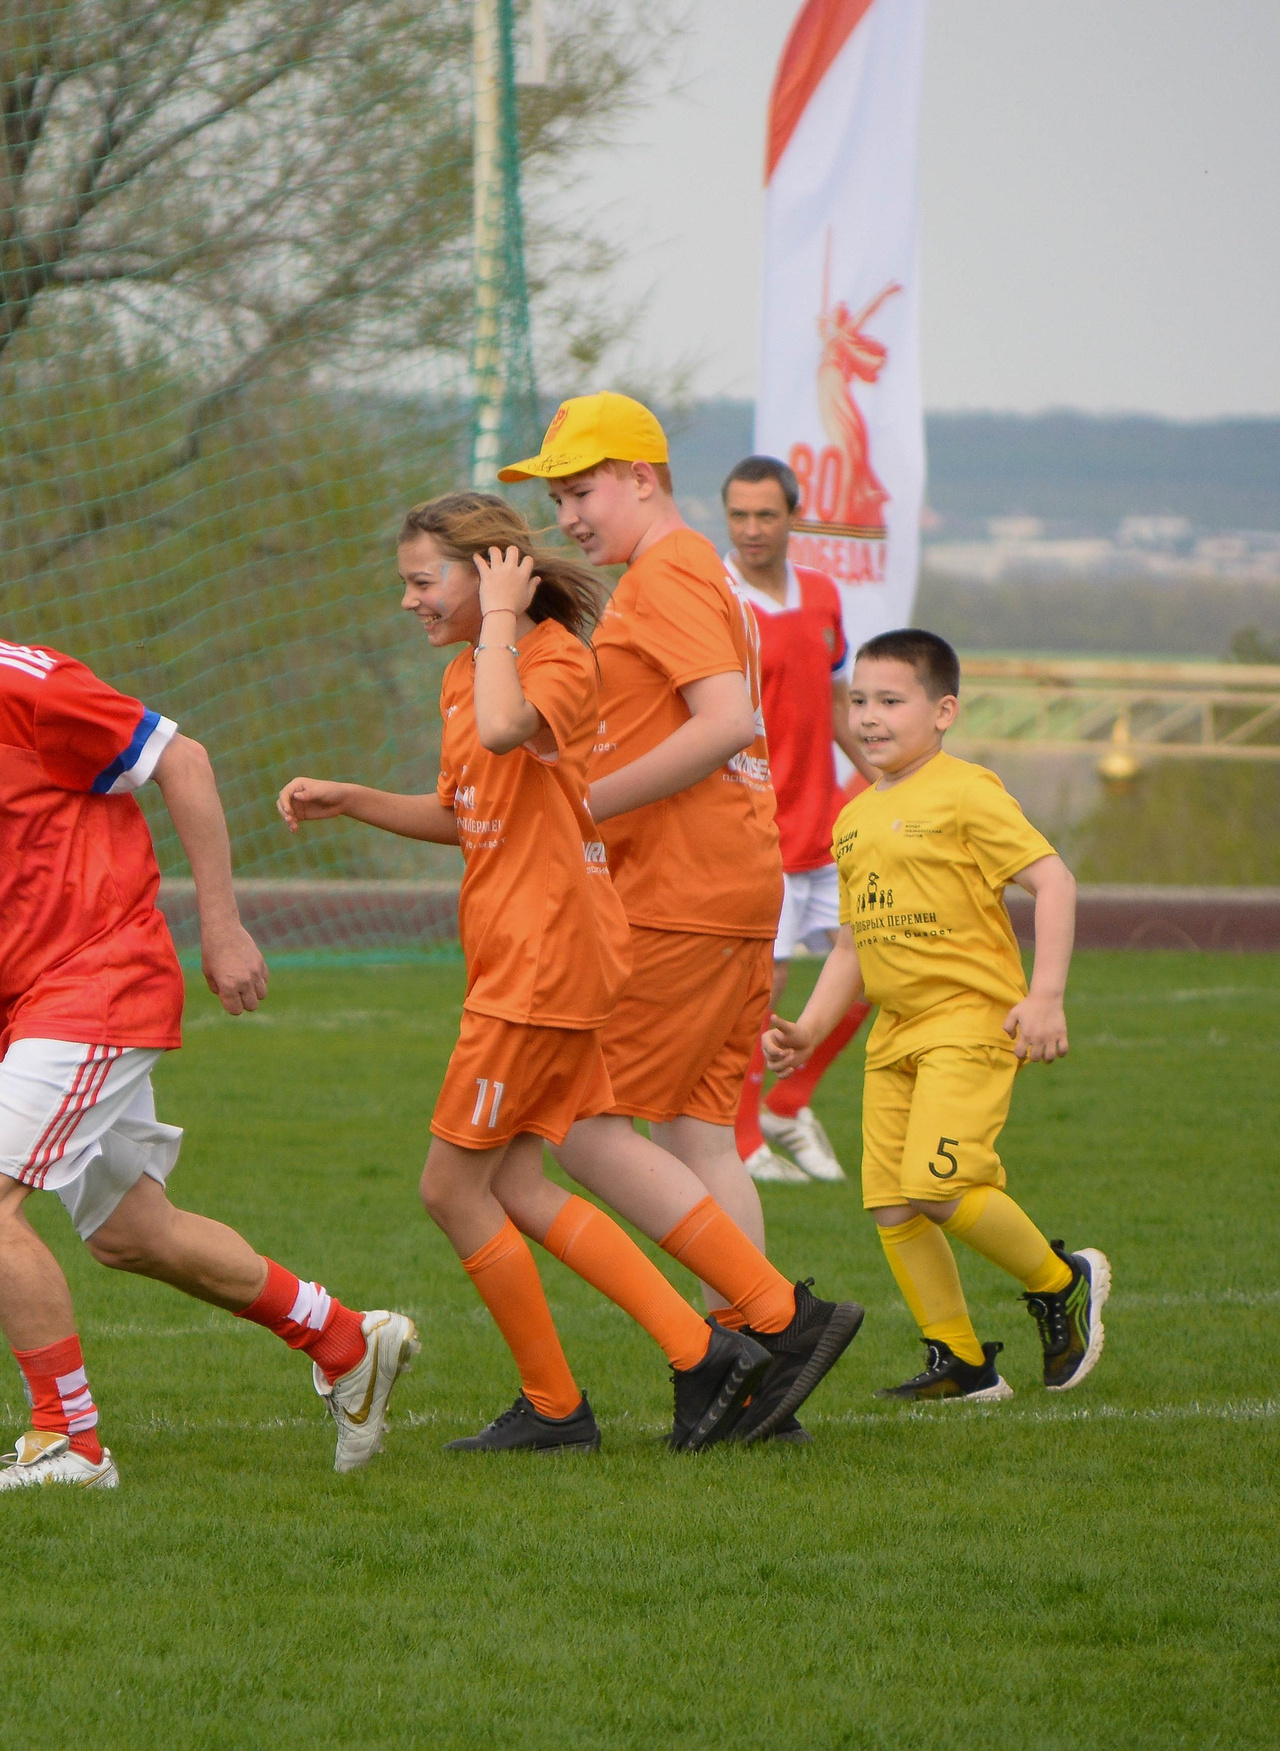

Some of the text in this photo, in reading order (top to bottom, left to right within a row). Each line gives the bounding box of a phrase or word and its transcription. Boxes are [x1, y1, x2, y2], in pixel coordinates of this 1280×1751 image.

[887, 912, 937, 927] ПЕРЕМЕН
[904, 928, 953, 939] бывает
[471, 1078, 504, 1128] 11
[928, 1136, 959, 1179] 5
